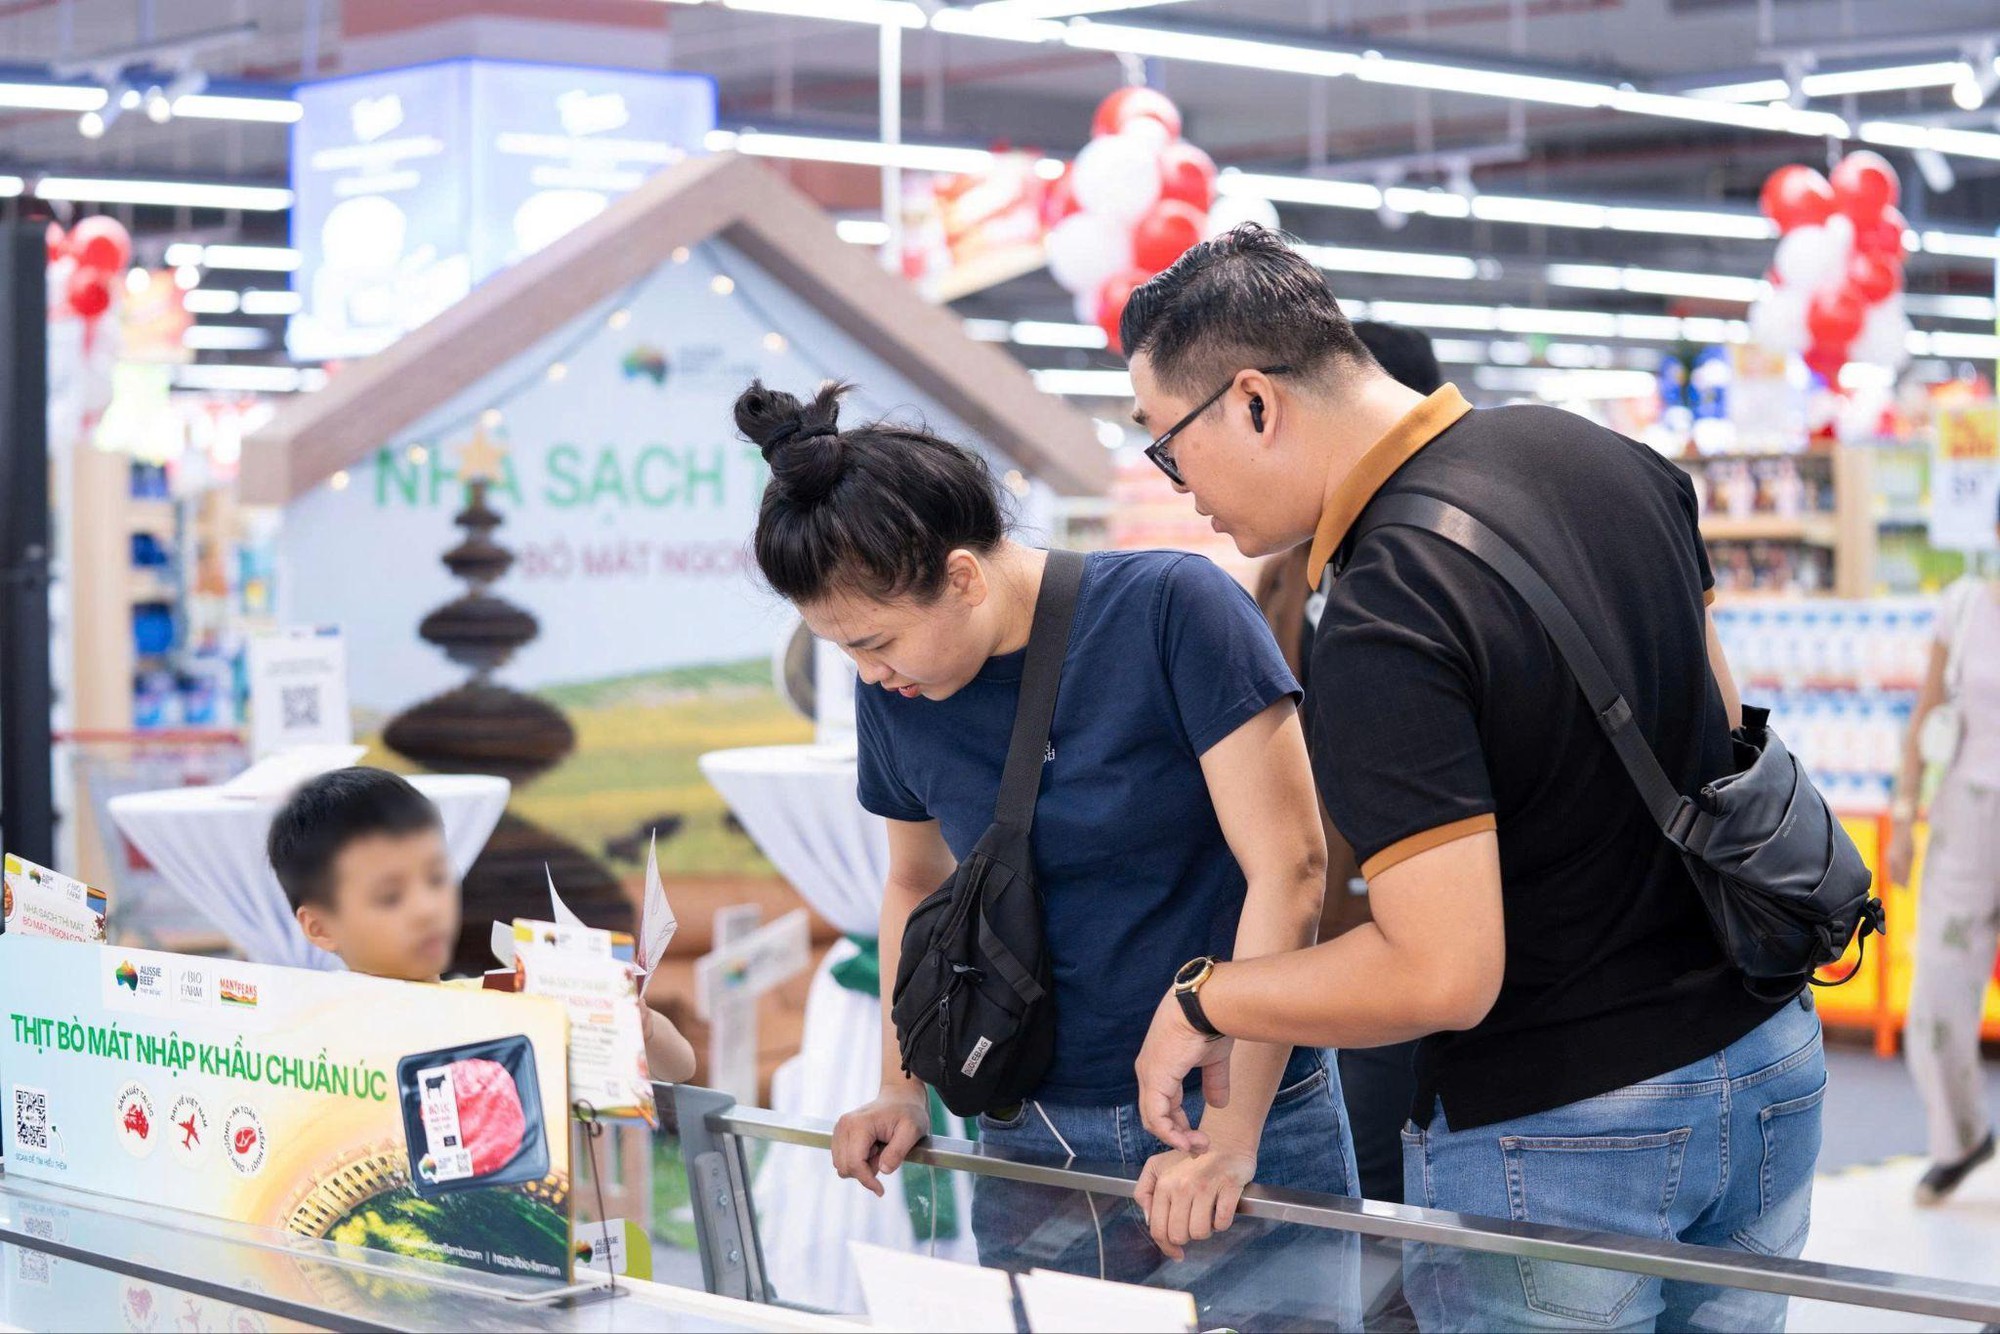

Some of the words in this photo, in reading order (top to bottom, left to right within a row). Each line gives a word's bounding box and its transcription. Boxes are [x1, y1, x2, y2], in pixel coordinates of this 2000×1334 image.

[544, 441, 726, 526] SẠCH
[140, 965, 162, 978] AUSSIE
[140, 975, 154, 986] BEEF
[219, 976, 258, 997] MANYPEAKS
[180, 984, 203, 998] FARM
[11, 1013, 54, 1055] THỊT
[58, 1015, 85, 1053] BÒ
[88, 1021, 132, 1061] MÁT
[136, 1030, 196, 1078] NHẬP
[200, 1034, 262, 1082] KHẨU
[266, 1047, 349, 1096] CHUẨN
[354, 1059, 387, 1101] ÚC
